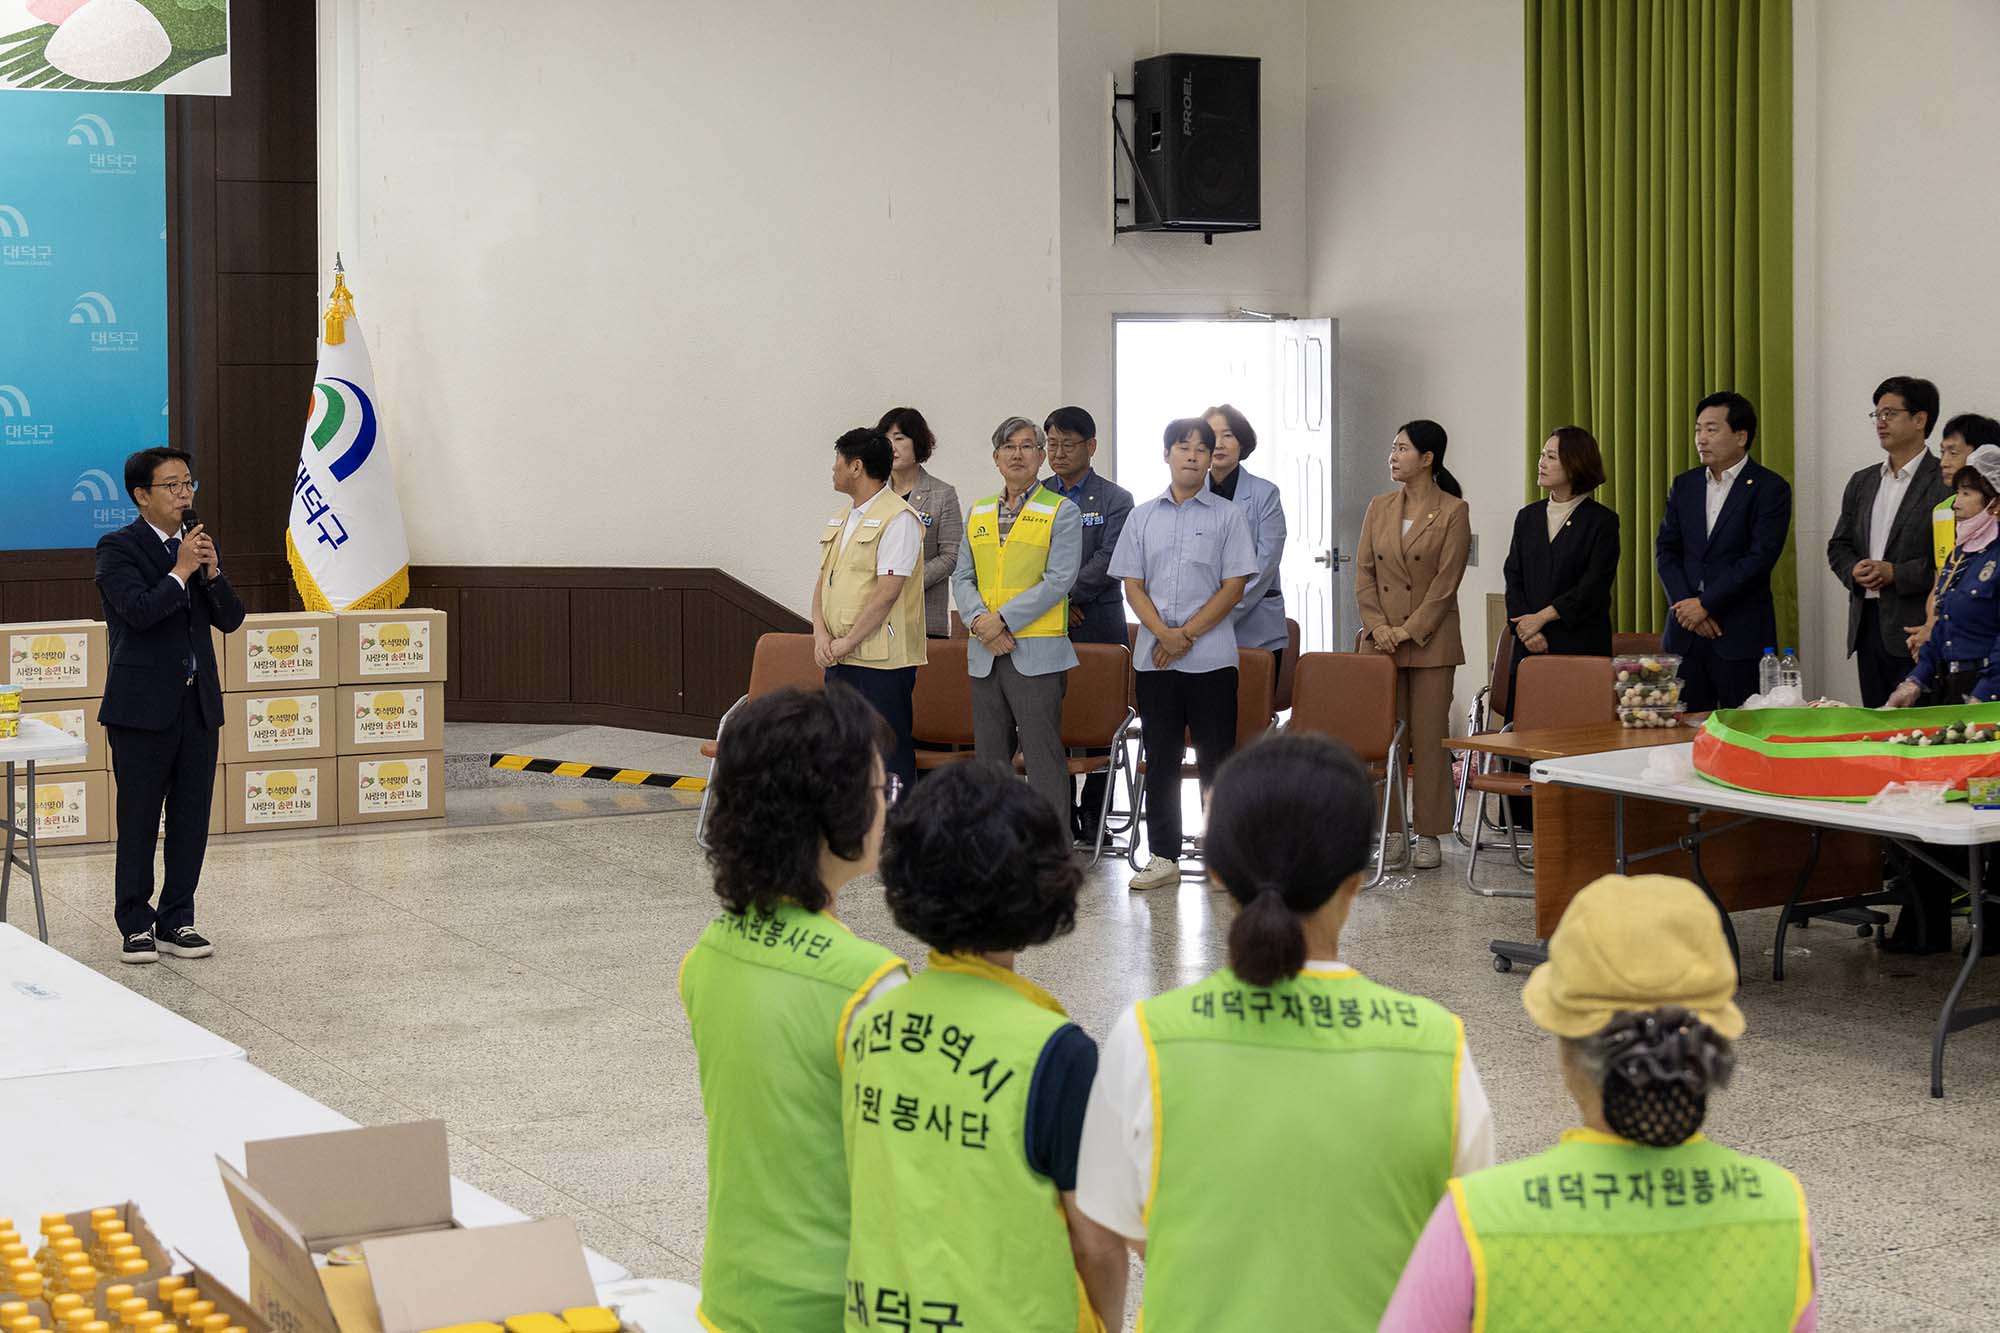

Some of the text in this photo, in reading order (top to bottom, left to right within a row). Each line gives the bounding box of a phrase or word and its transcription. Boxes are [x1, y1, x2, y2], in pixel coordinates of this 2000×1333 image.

[1183, 71, 1192, 137] PROEL
[89, 152, 137, 168] 대덕구
[3, 245, 53, 259] 대덕구
[91, 331, 139, 345] 대덕구
[5, 424, 54, 439] 대덕구
[379, 638, 410, 648] 추석맞이
[267, 644, 299, 654] 추석맞이
[32, 651, 65, 660] 추석맞이
[365, 651, 424, 662] 사랑의 송편 나눔
[253, 658, 313, 669] 사랑의 송편 나눔
[16, 665, 81, 676] 사랑의 송편 나눔
[374, 706, 404, 716] 추석맞이
[267, 713, 299, 723] 추석맞이
[360, 720, 418, 731] 사랑의 송편 나눔
[253, 727, 313, 739] 사랑의 송편 나눔
[378, 776, 409, 786] 추석맞이
[266, 785, 297, 796] 추석맞이
[364, 789, 422, 801] 사랑의 송편 나눔
[36, 800, 64, 810] 석맞이
[252, 800, 311, 811] 사랑의 송편 나눔
[44, 815, 60, 825] 송편
[62, 815, 80, 824] 나눔
[1191, 989, 1419, 1029] 대덕구자원봉사단
[856, 1083, 990, 1151] 원봉사단
[1523, 1163, 1764, 1210] 대덕구자원봉사단
